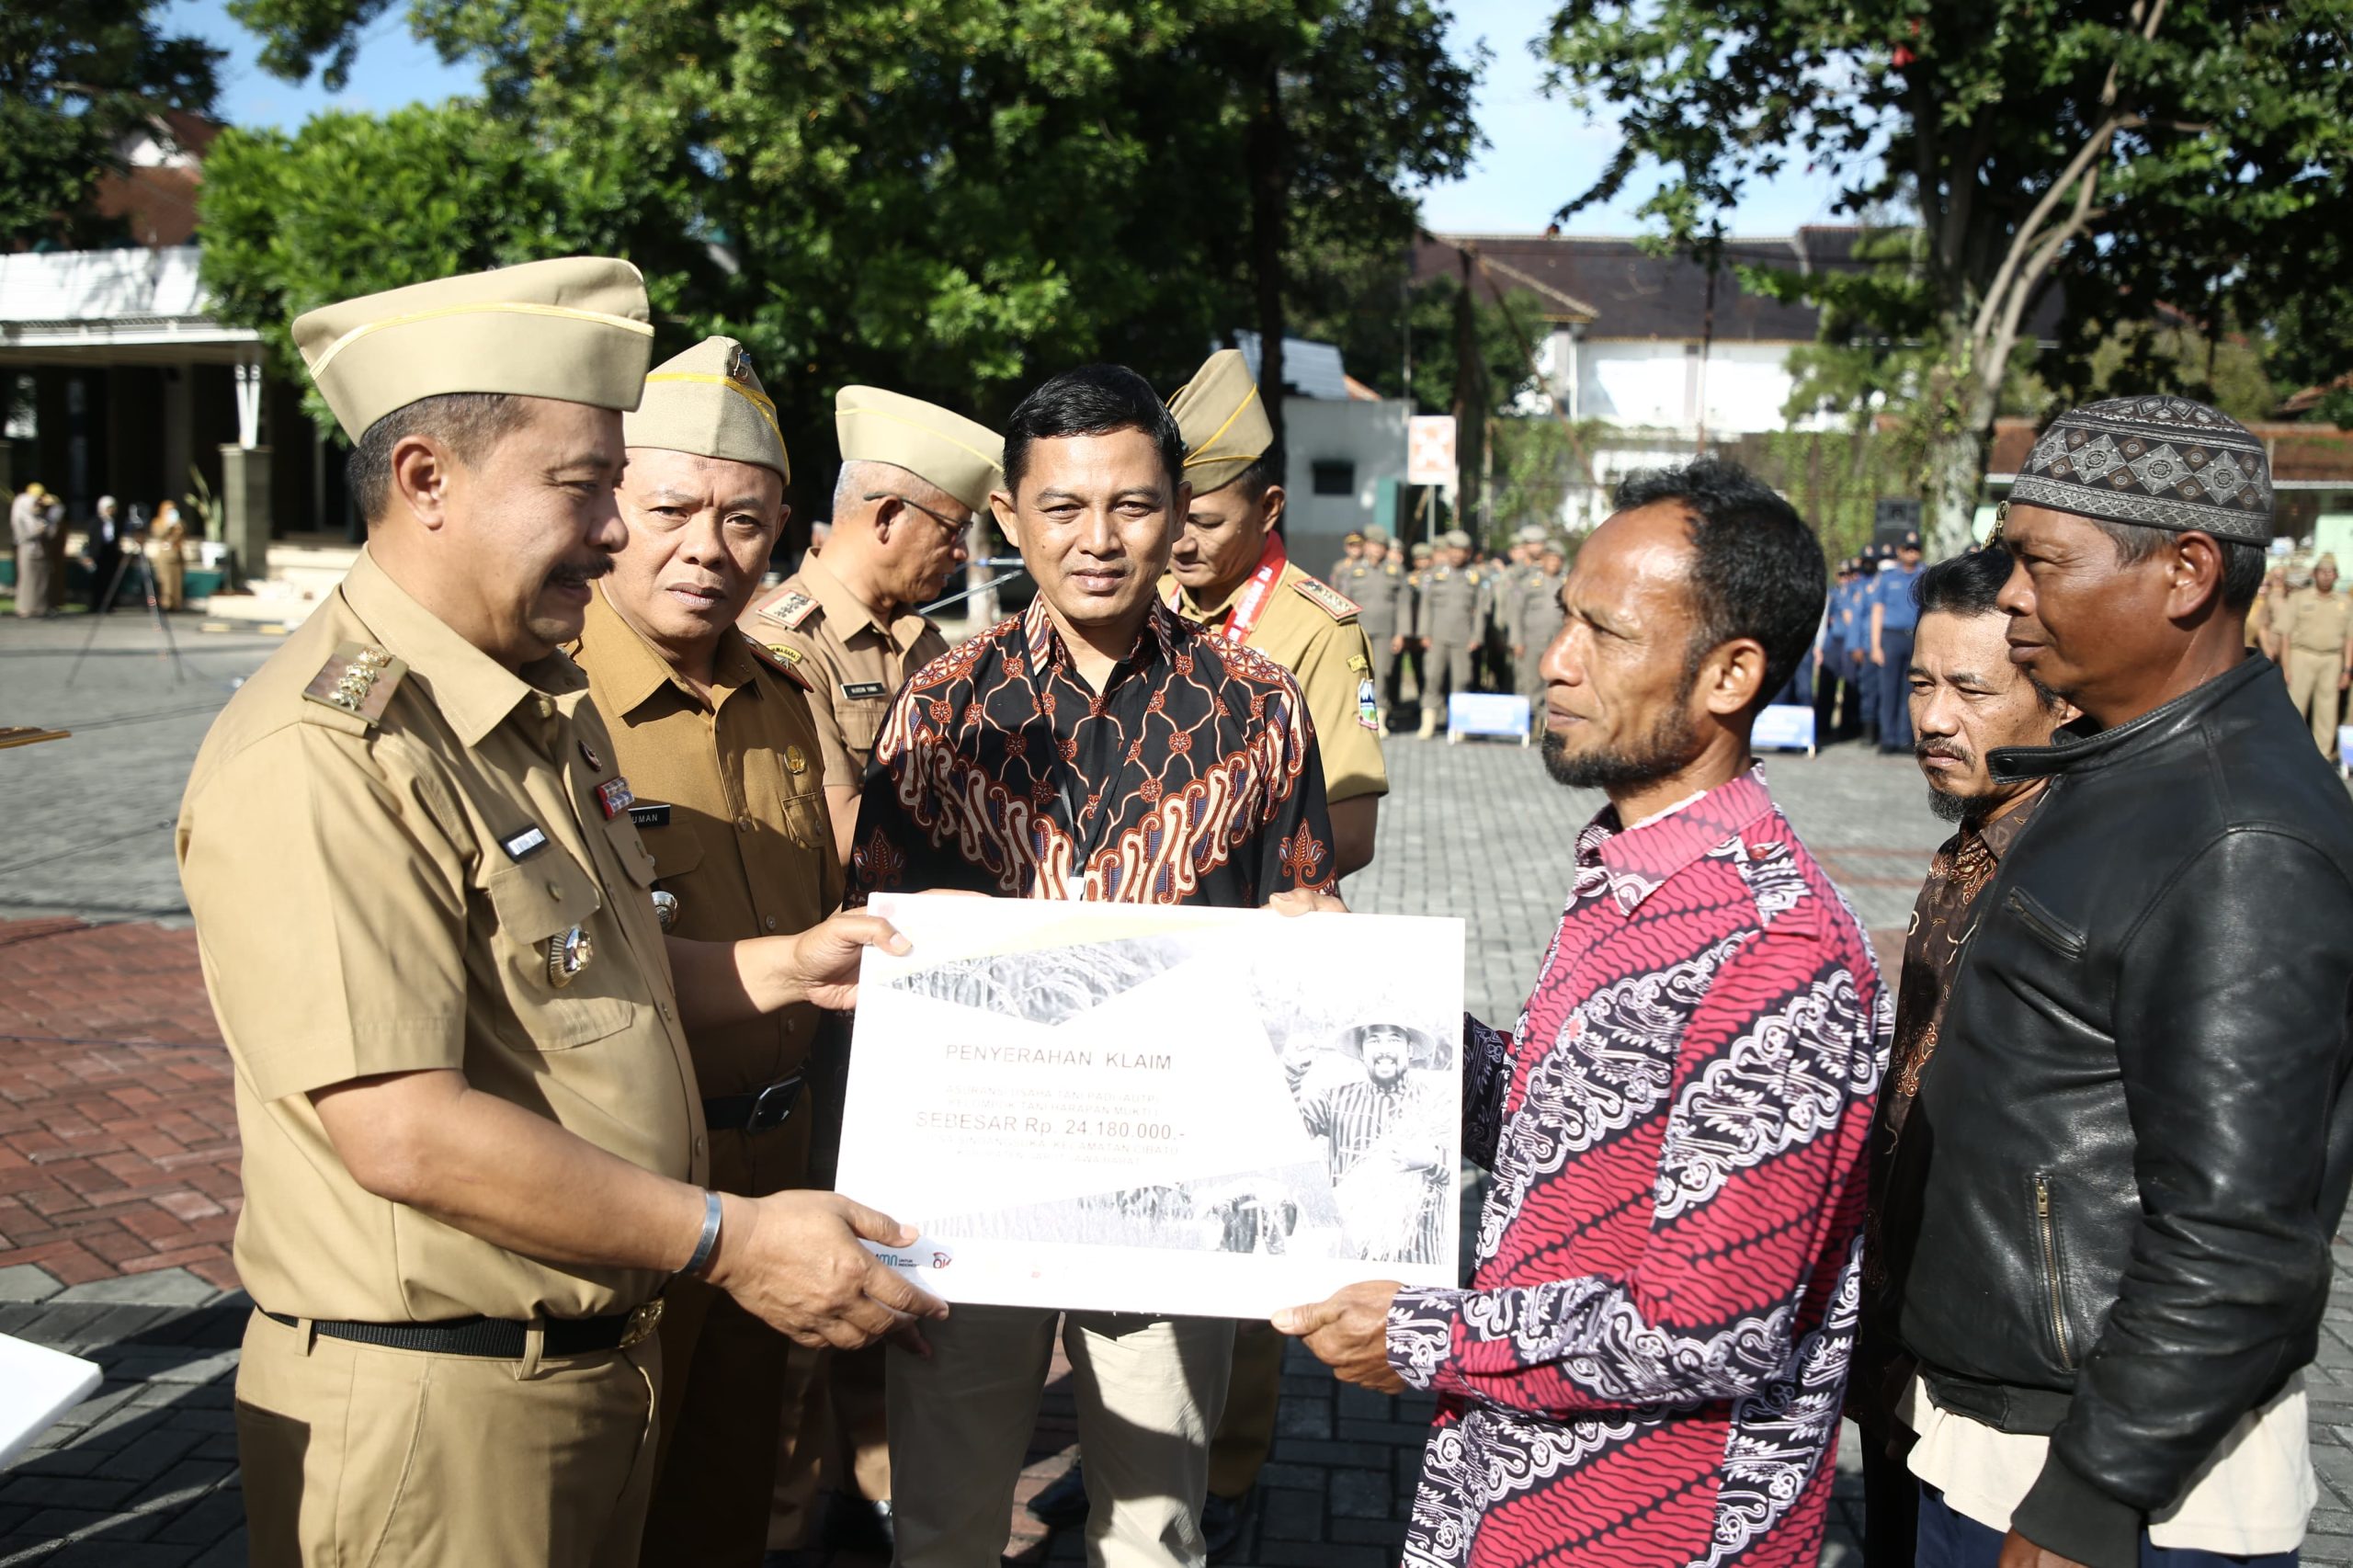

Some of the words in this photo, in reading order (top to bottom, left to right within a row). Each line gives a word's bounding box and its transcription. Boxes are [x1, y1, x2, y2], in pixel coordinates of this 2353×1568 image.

[631, 813, 658, 824] UMAN
[946, 1044, 1092, 1066] PENYERAHAN
[1106, 1052, 1172, 1071] KLAIM
[946, 1085, 1007, 1097] ASURANSI
[1058, 1089, 1085, 1100] TANI
[1021, 1101, 1047, 1112] TANI
[1051, 1103, 1109, 1115] HARAPAN
[915, 1110, 1017, 1131] SEBESAR
